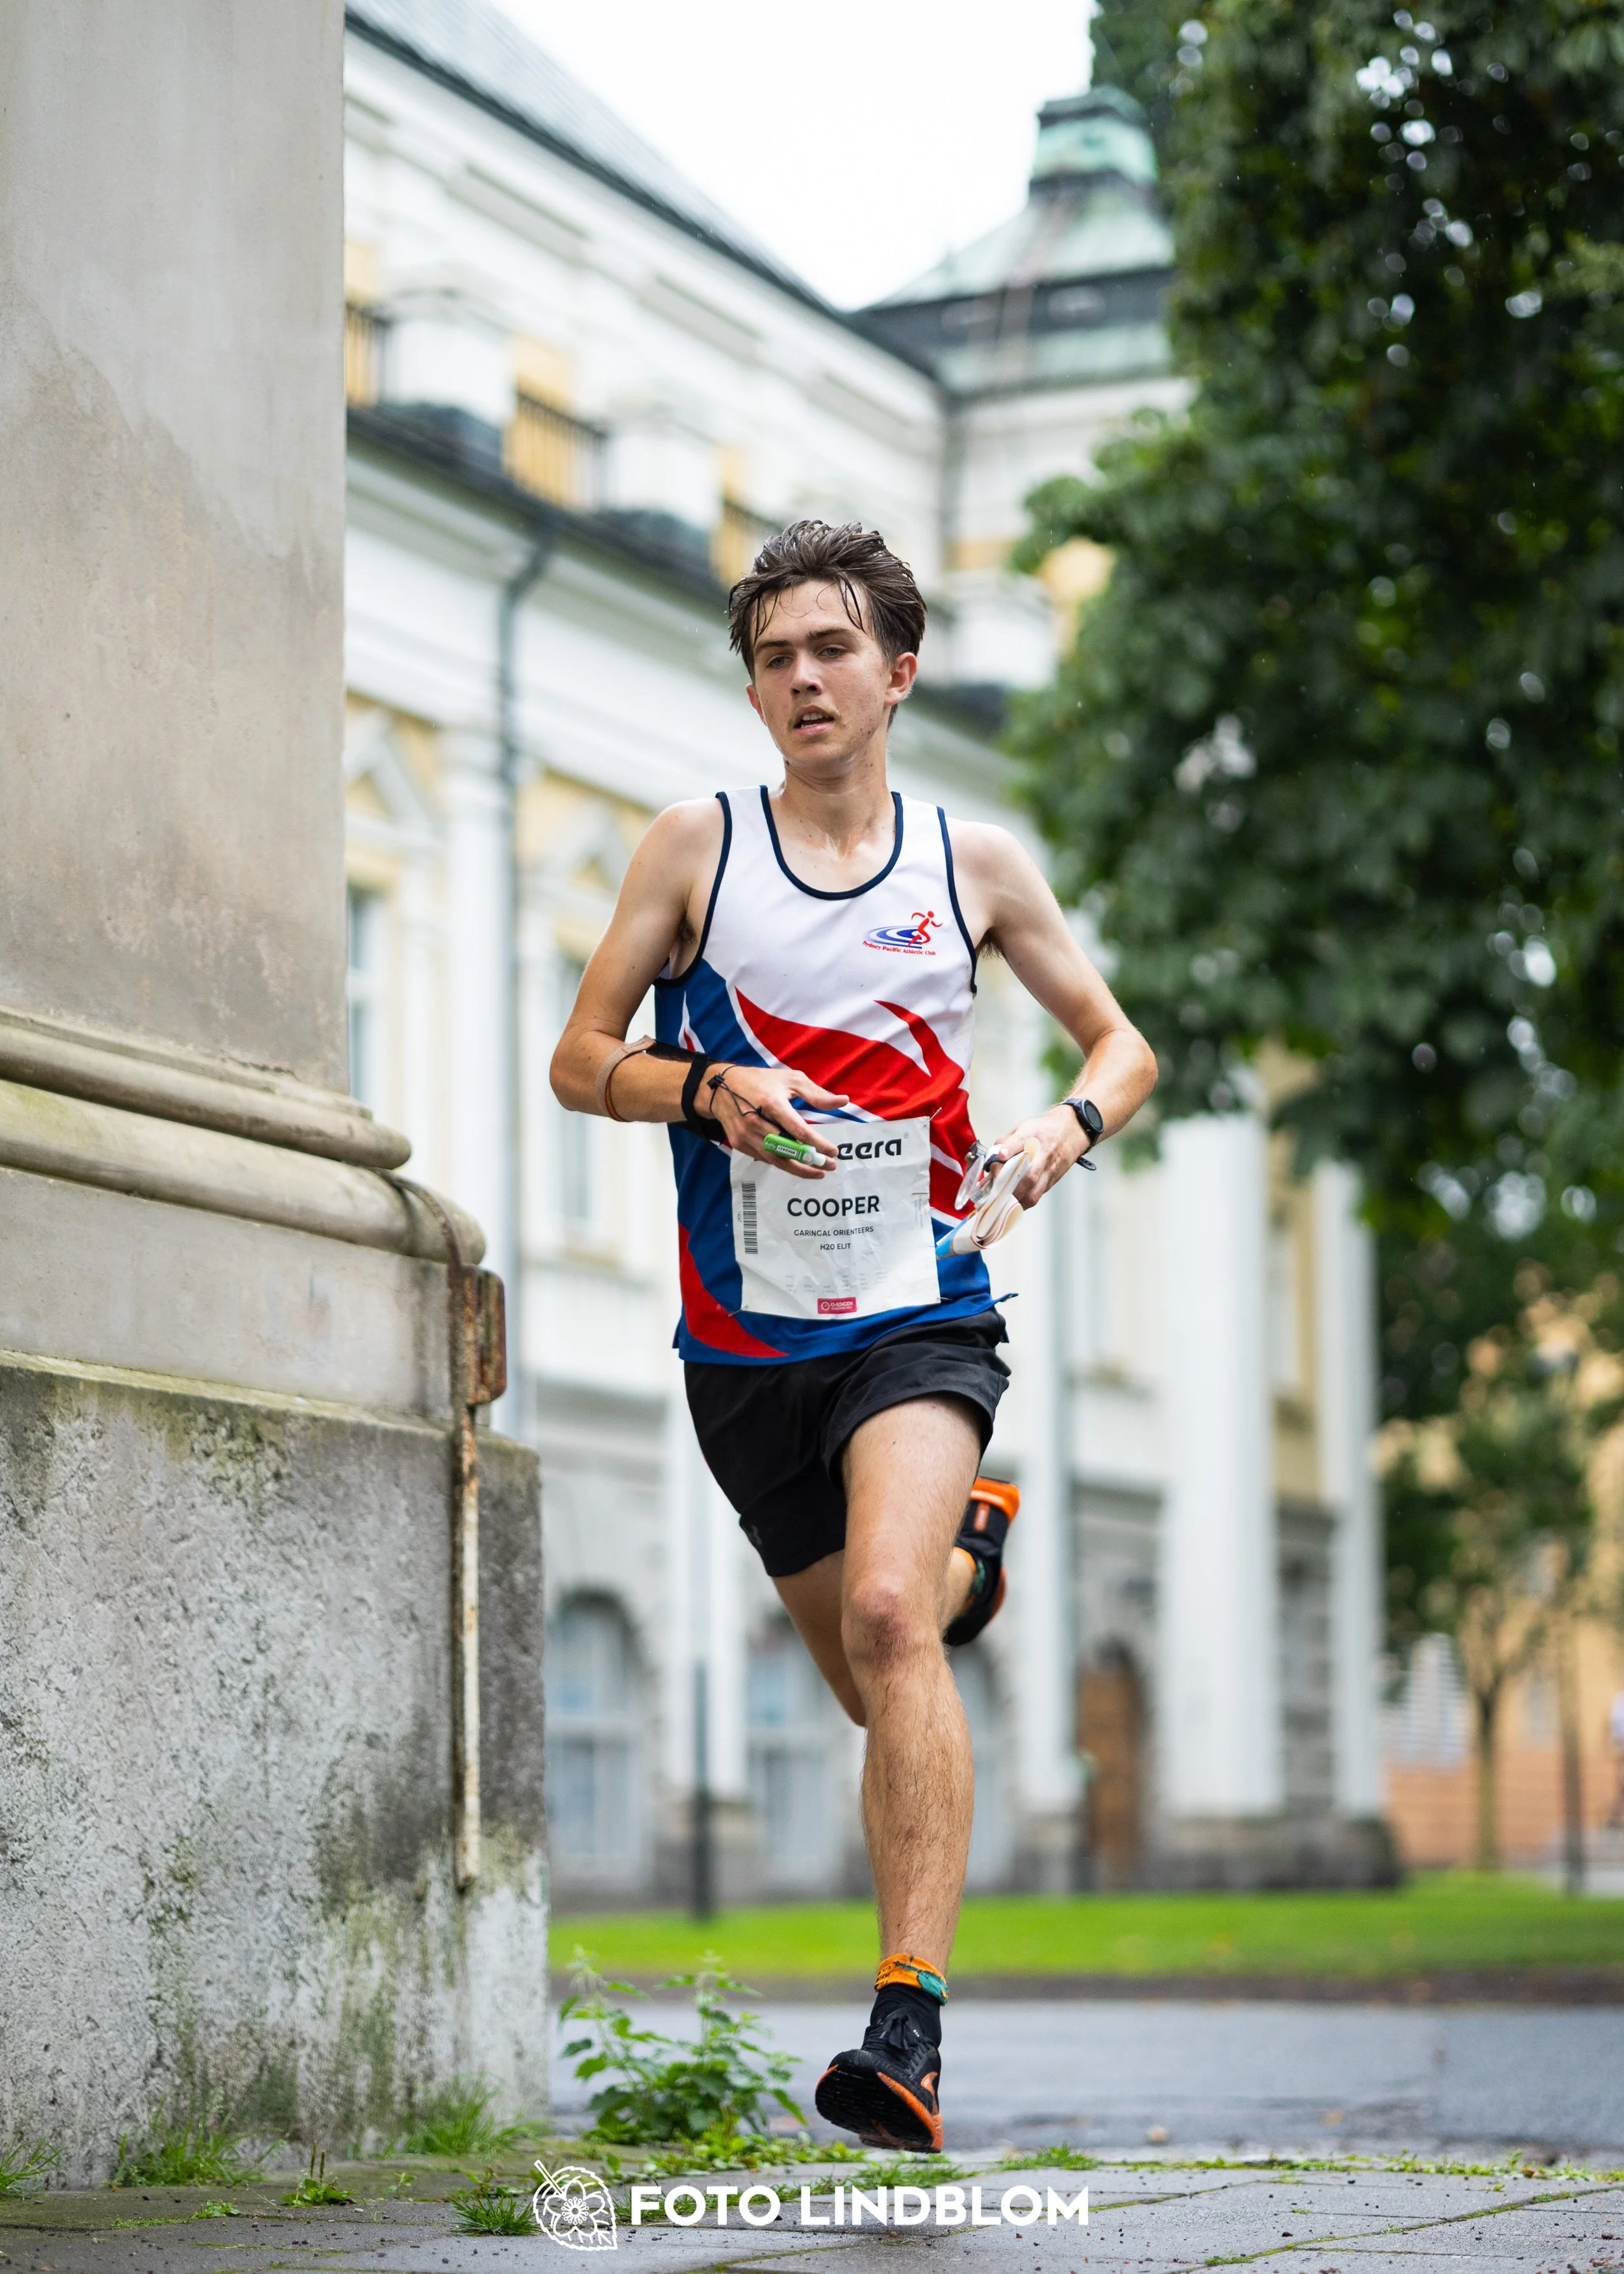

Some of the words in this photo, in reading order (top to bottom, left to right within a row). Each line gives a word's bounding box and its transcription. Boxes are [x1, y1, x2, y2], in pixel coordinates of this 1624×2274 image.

[862, 941, 882, 949] Sydney
[787, 1195, 880, 1217] COOPER
[833, 1226, 874, 1236] ORIENTEERS
